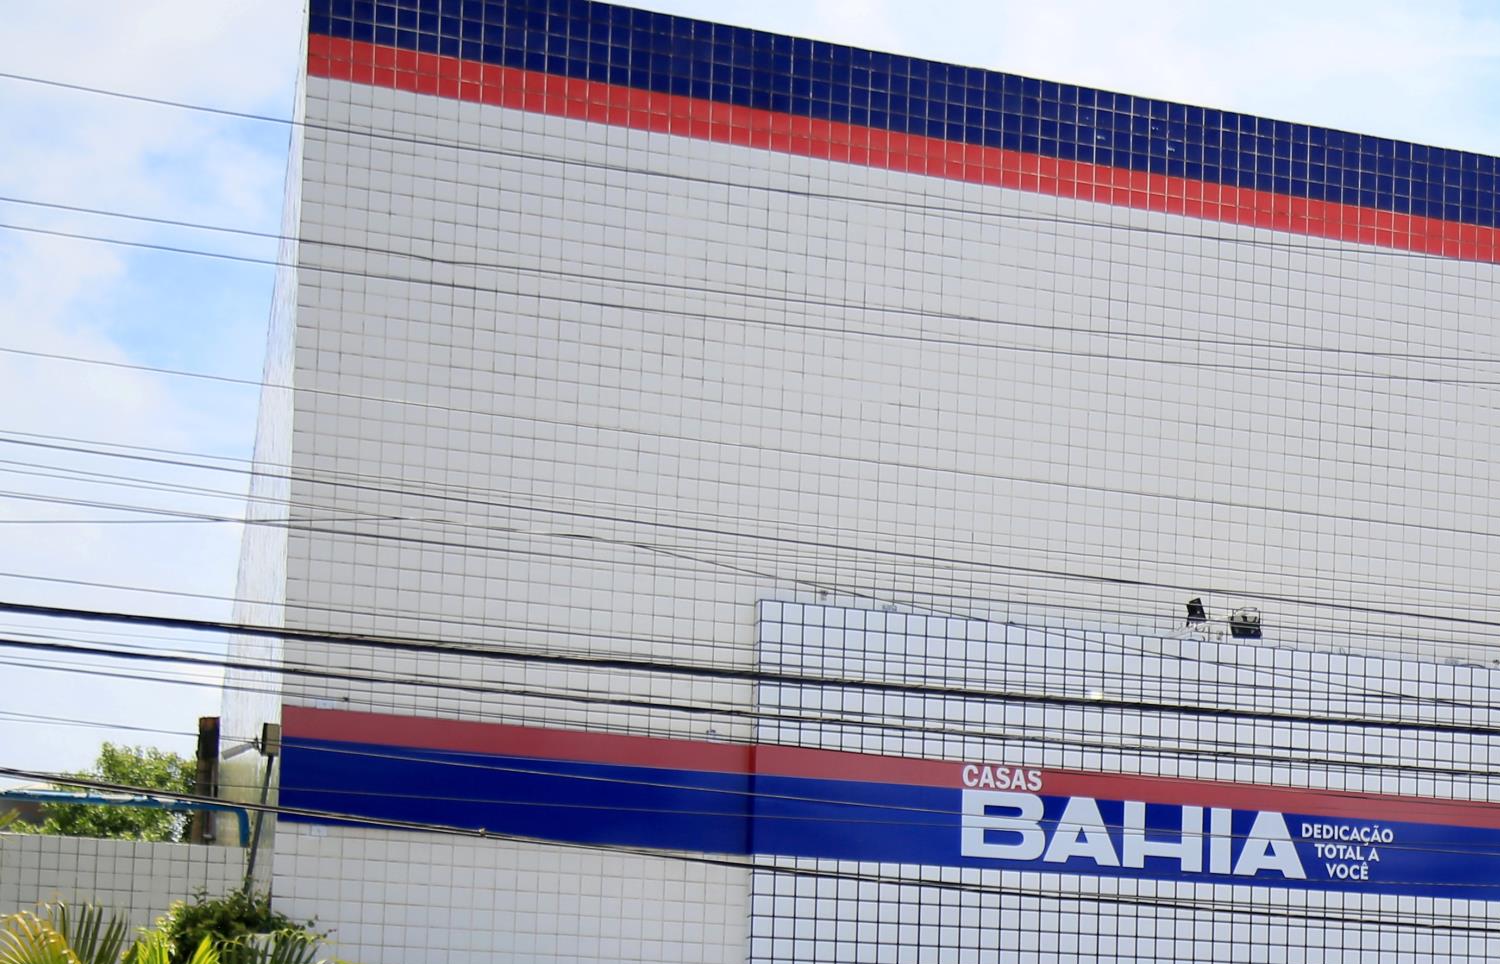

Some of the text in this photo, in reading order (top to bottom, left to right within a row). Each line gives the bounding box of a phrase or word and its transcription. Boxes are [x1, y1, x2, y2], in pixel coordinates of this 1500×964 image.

[962, 764, 1043, 792] CASAS
[960, 788, 1307, 880] BAHIA
[1301, 822, 1394, 847] DEDICAÇÃO
[1315, 843, 1380, 862] TOTAL A
[1325, 861, 1369, 880] VOCÊ
